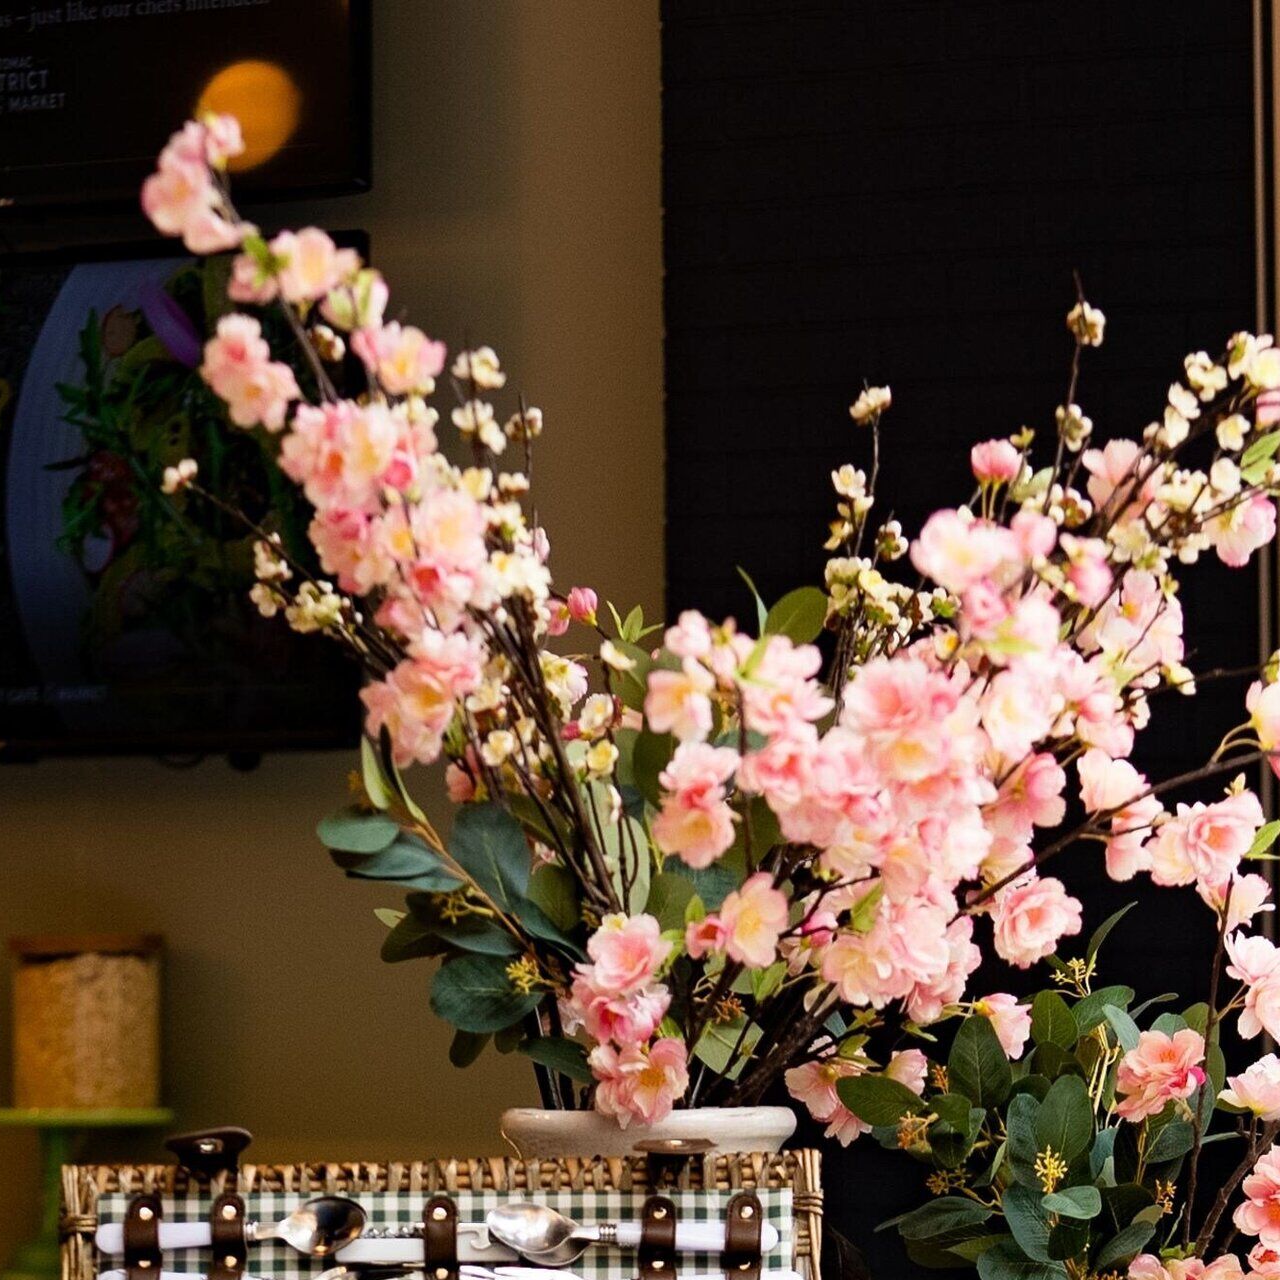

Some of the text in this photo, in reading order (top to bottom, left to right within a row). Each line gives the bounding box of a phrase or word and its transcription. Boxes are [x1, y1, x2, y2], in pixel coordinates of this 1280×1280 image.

[28, 7, 61, 32] just
[65, 0, 98, 22] like
[102, 3, 132, 18] our
[7, 92, 66, 113] MARKET
